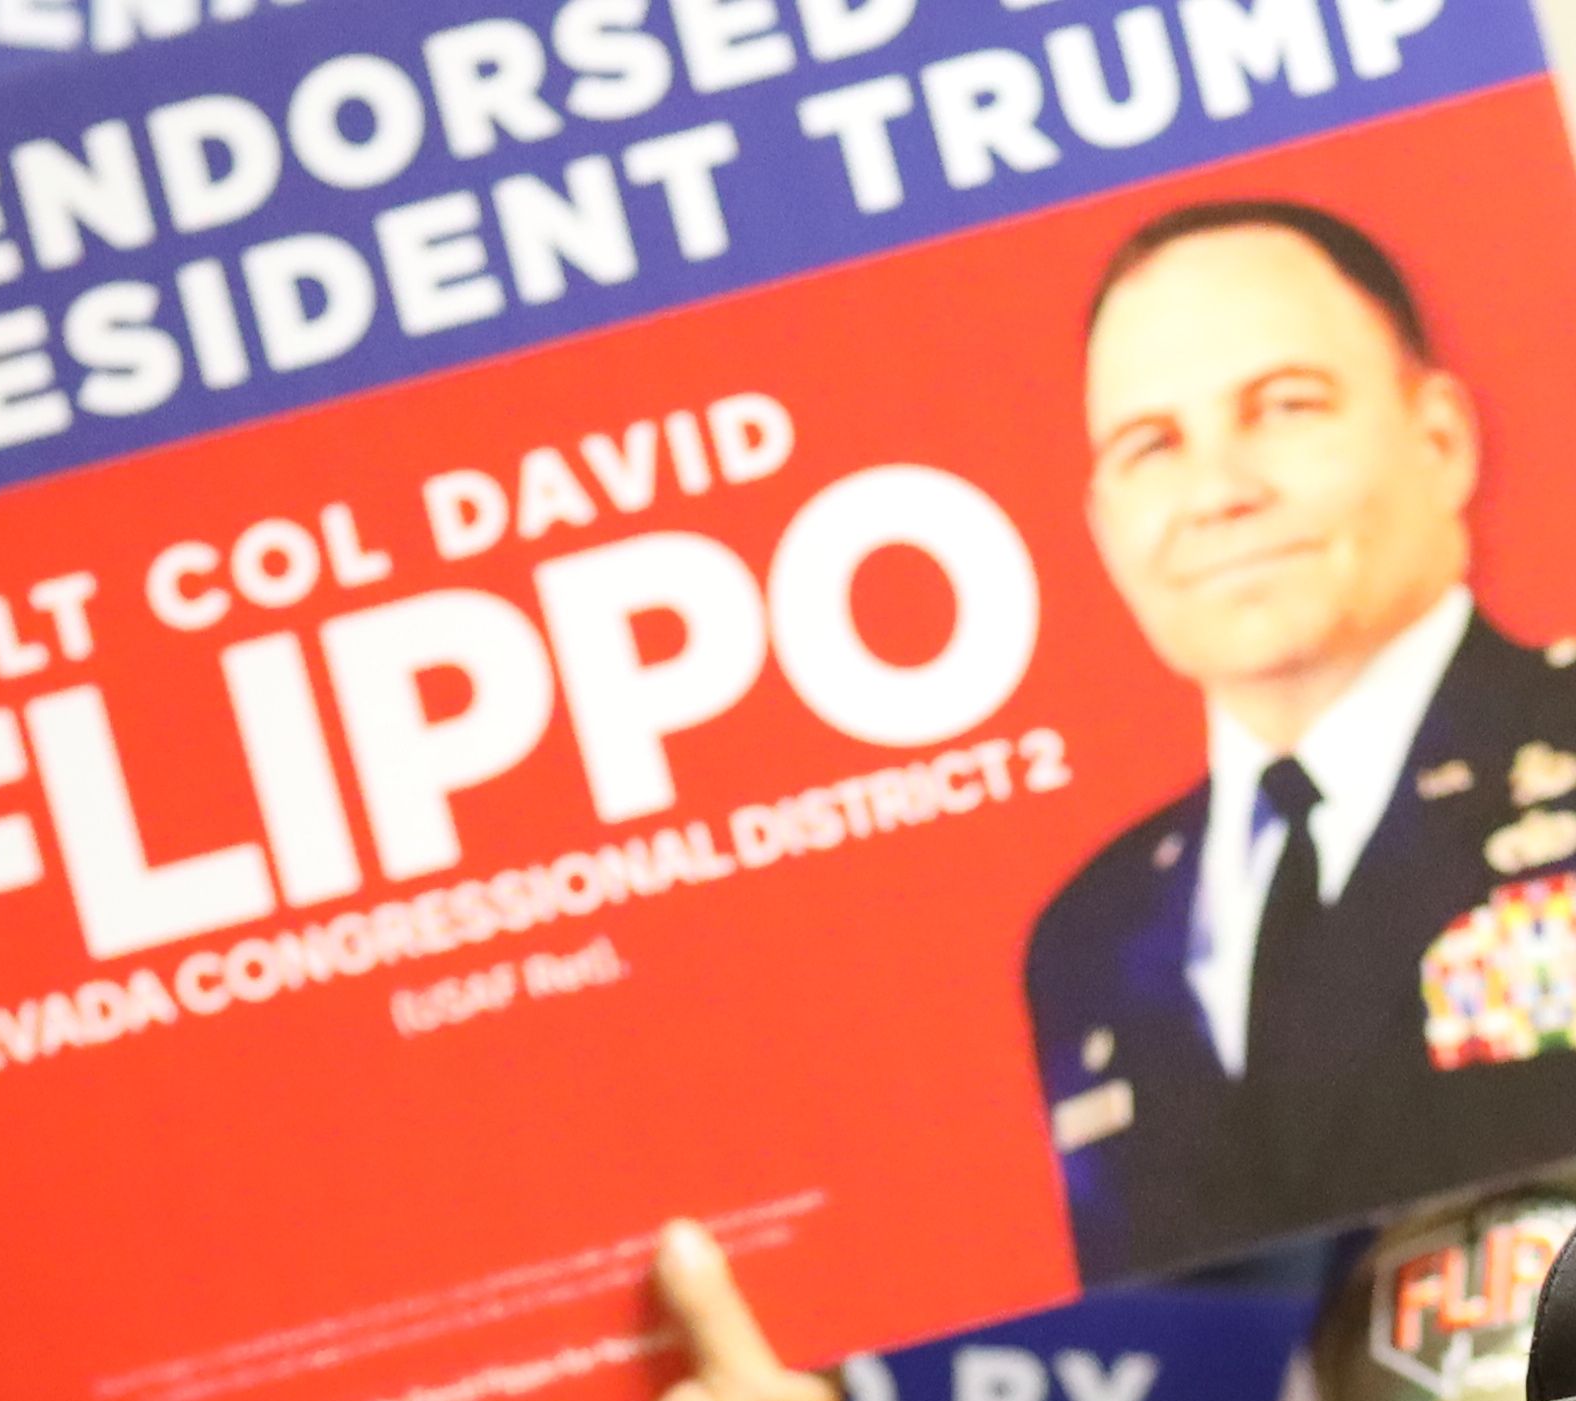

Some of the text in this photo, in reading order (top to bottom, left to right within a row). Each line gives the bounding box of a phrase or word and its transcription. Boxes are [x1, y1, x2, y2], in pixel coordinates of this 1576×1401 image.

[796, 0, 1442, 215] TRUMP
[144, 502, 392, 633] COL
[429, 392, 796, 562] DAVID
[179, 835, 732, 1015] CONGRESSIONAL
[729, 762, 1014, 870] DISTRICT
[1014, 728, 1070, 795] 2
[1391, 1225, 1554, 1353] FLIP
